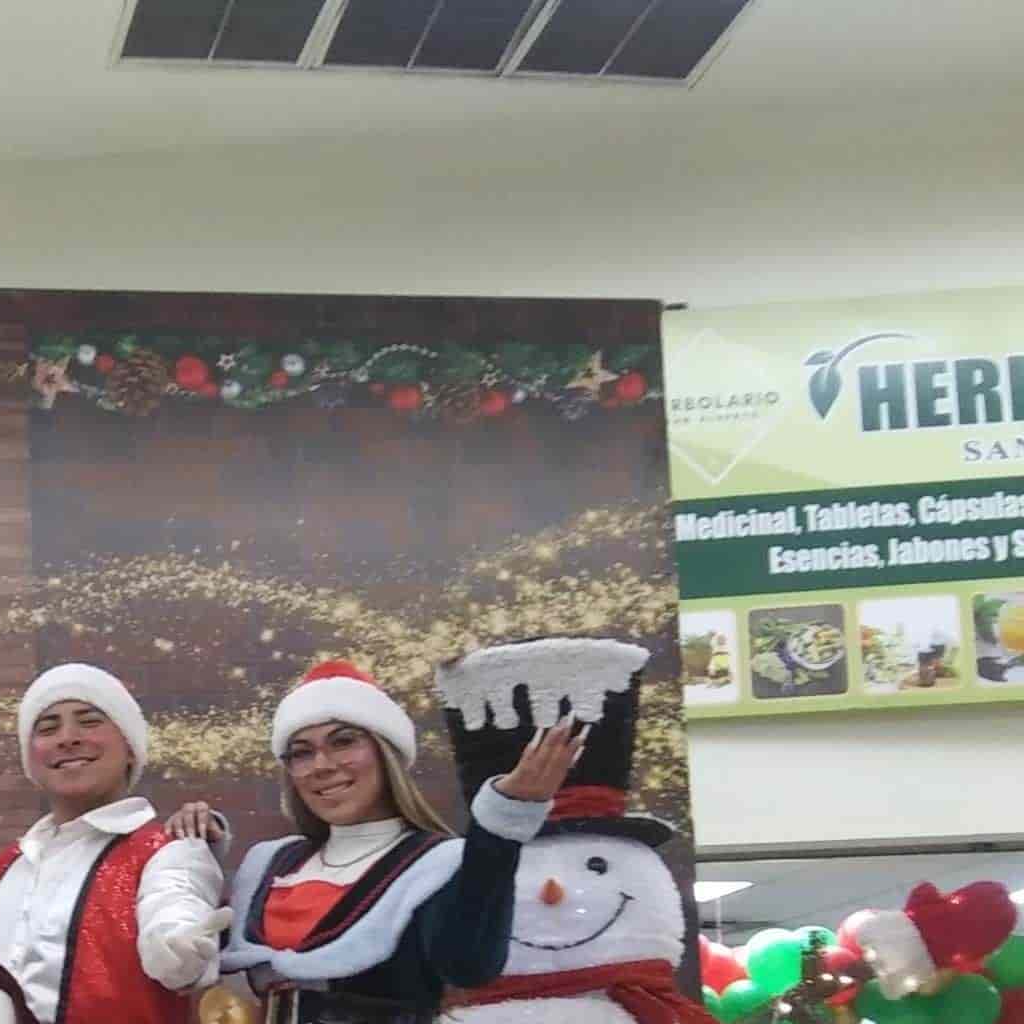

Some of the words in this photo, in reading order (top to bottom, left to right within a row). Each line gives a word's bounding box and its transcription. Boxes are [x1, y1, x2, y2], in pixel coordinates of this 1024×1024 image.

[675, 505, 802, 541] Medicinal,
[803, 501, 917, 532] Tabletas,
[768, 541, 885, 574] Esencias,
[887, 536, 992, 566] Jabones
[991, 535, 1009, 562] y
